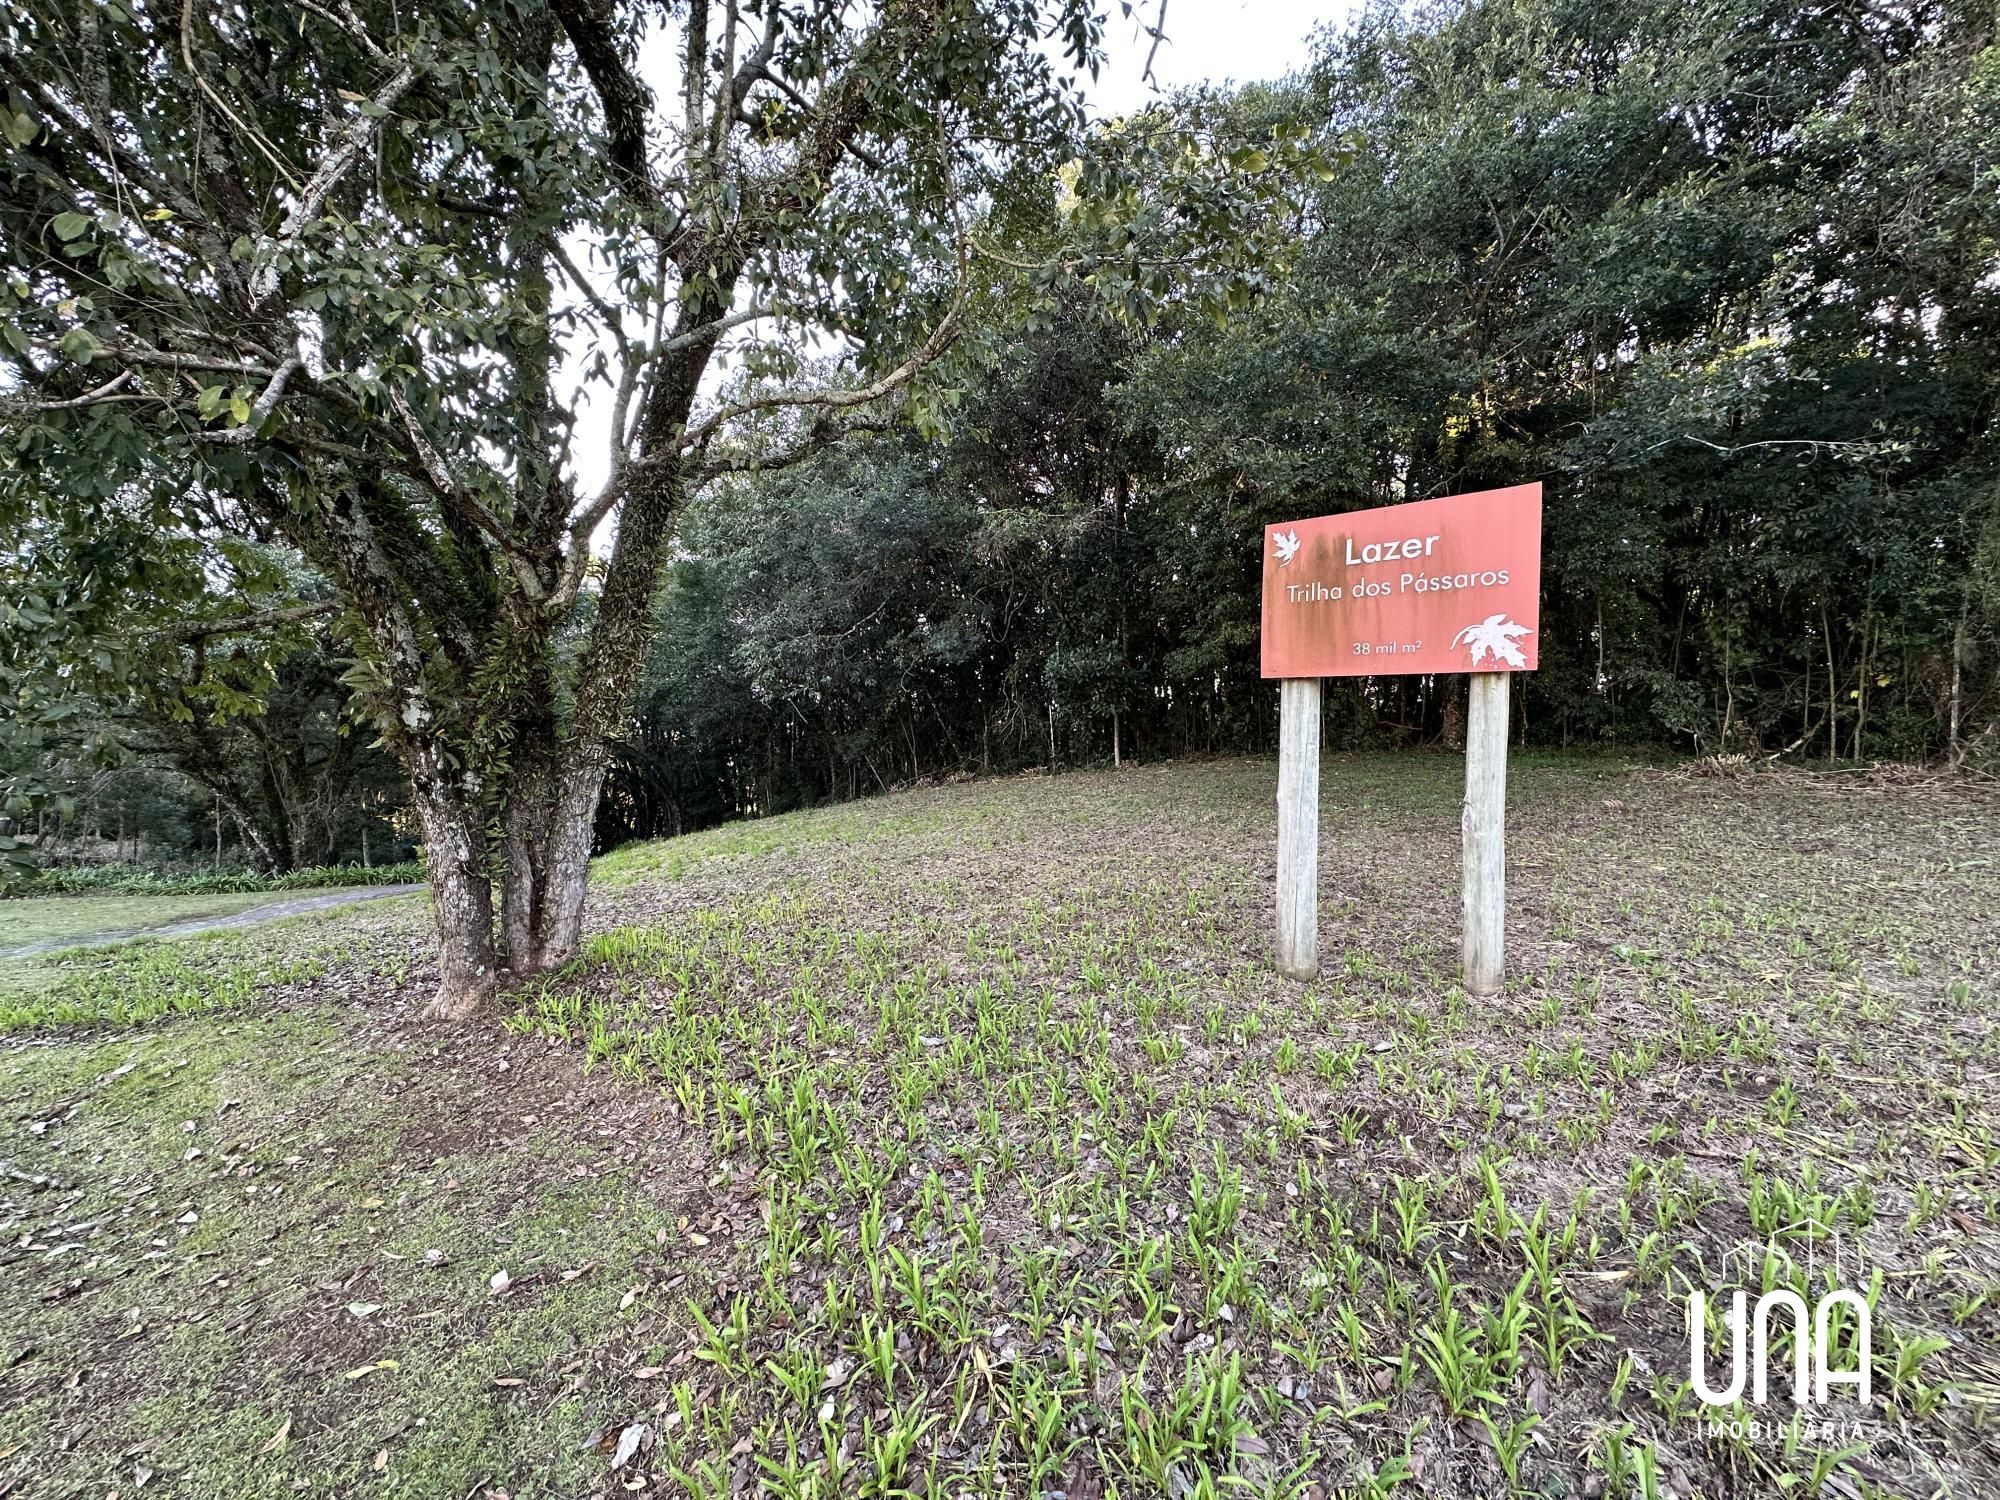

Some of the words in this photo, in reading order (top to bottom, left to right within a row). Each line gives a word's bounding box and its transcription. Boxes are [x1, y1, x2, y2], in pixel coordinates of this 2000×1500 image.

[1345, 535, 1440, 566] Lazer
[1286, 582, 1342, 603] Trilha
[1352, 577, 1391, 598] dos
[1400, 568, 1510, 594] Pássaros
[1352, 643, 1371, 656] 38
[1375, 641, 1397, 655] mil
